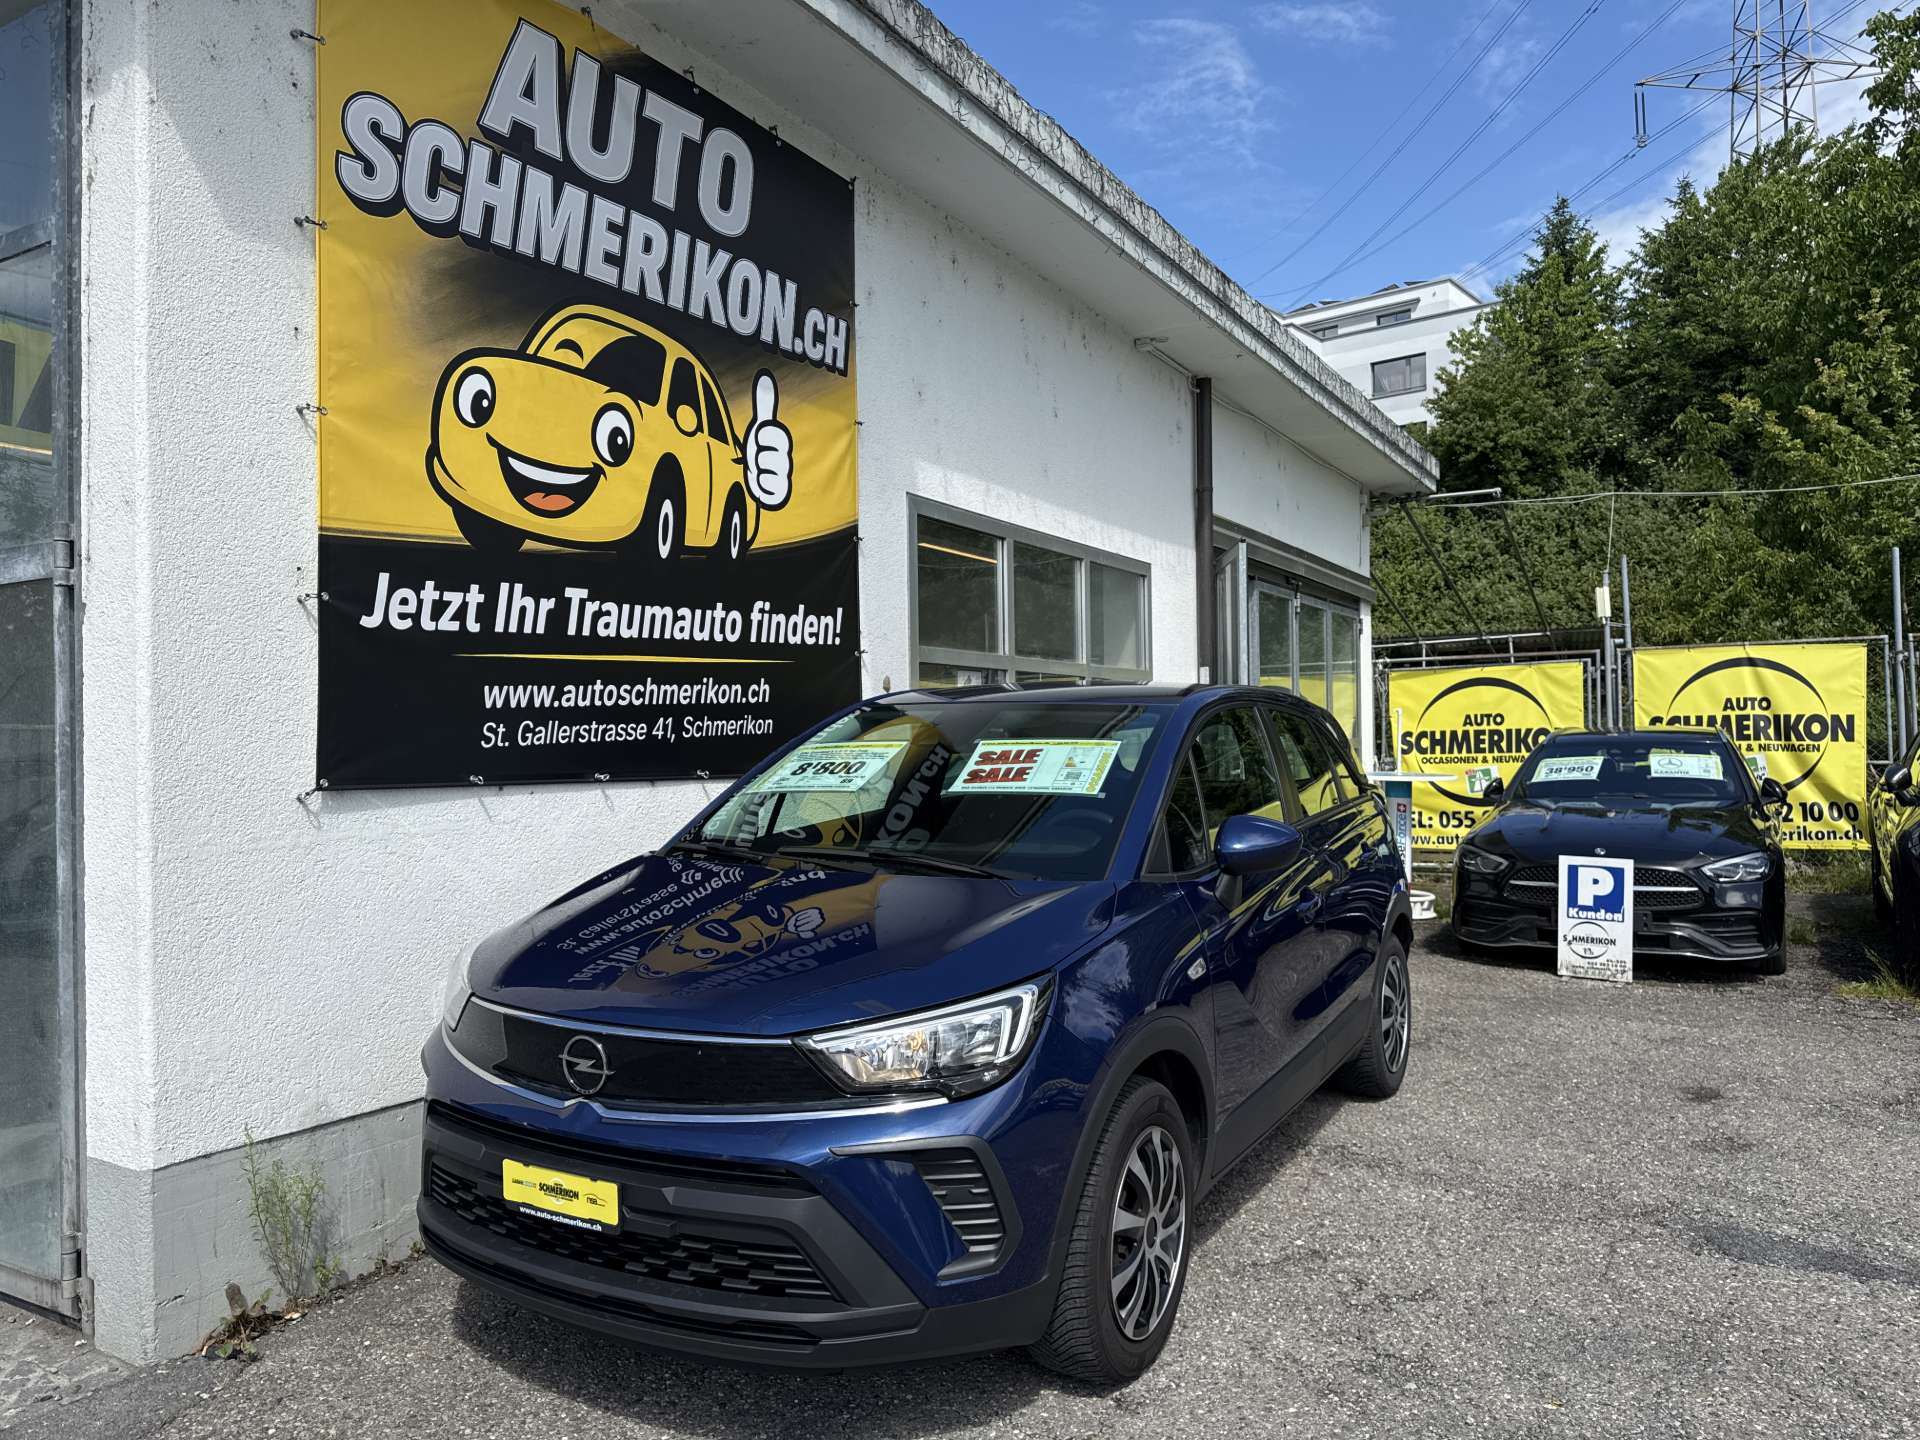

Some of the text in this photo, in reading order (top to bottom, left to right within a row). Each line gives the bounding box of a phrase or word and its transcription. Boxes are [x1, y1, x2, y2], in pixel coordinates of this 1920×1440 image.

[479, 20, 755, 238] AUTO
[337, 93, 848, 371] SCHMERIKON.CH
[360, 571, 843, 646] Jetzt Ihr Traumauto finden!
[483, 677, 770, 709] www.autoschmerikon.ch
[1722, 697, 1772, 711] AUTO
[1463, 713, 1505, 727] AUTO
[481, 715, 773, 748] St. Gallerstrasse 41, Schmerikon
[1401, 727, 1552, 755] SCHMERIKO
[974, 748, 1044, 767] SALE
[1758, 743, 1821, 752] NEUWAGEN
[790, 760, 867, 776] 8'800
[1421, 756, 1478, 765] OCCASIONEN
[963, 766, 1034, 784] SALE
[1799, 801, 1824, 822] 10
[1828, 801, 1859, 822] 00
[1577, 866, 1614, 907] P
[1567, 906, 1623, 922] Kunden
[538, 1182, 580, 1200] SCHMERIKON
[520, 1206, 602, 1232] www.auto-schmerikon.ch
